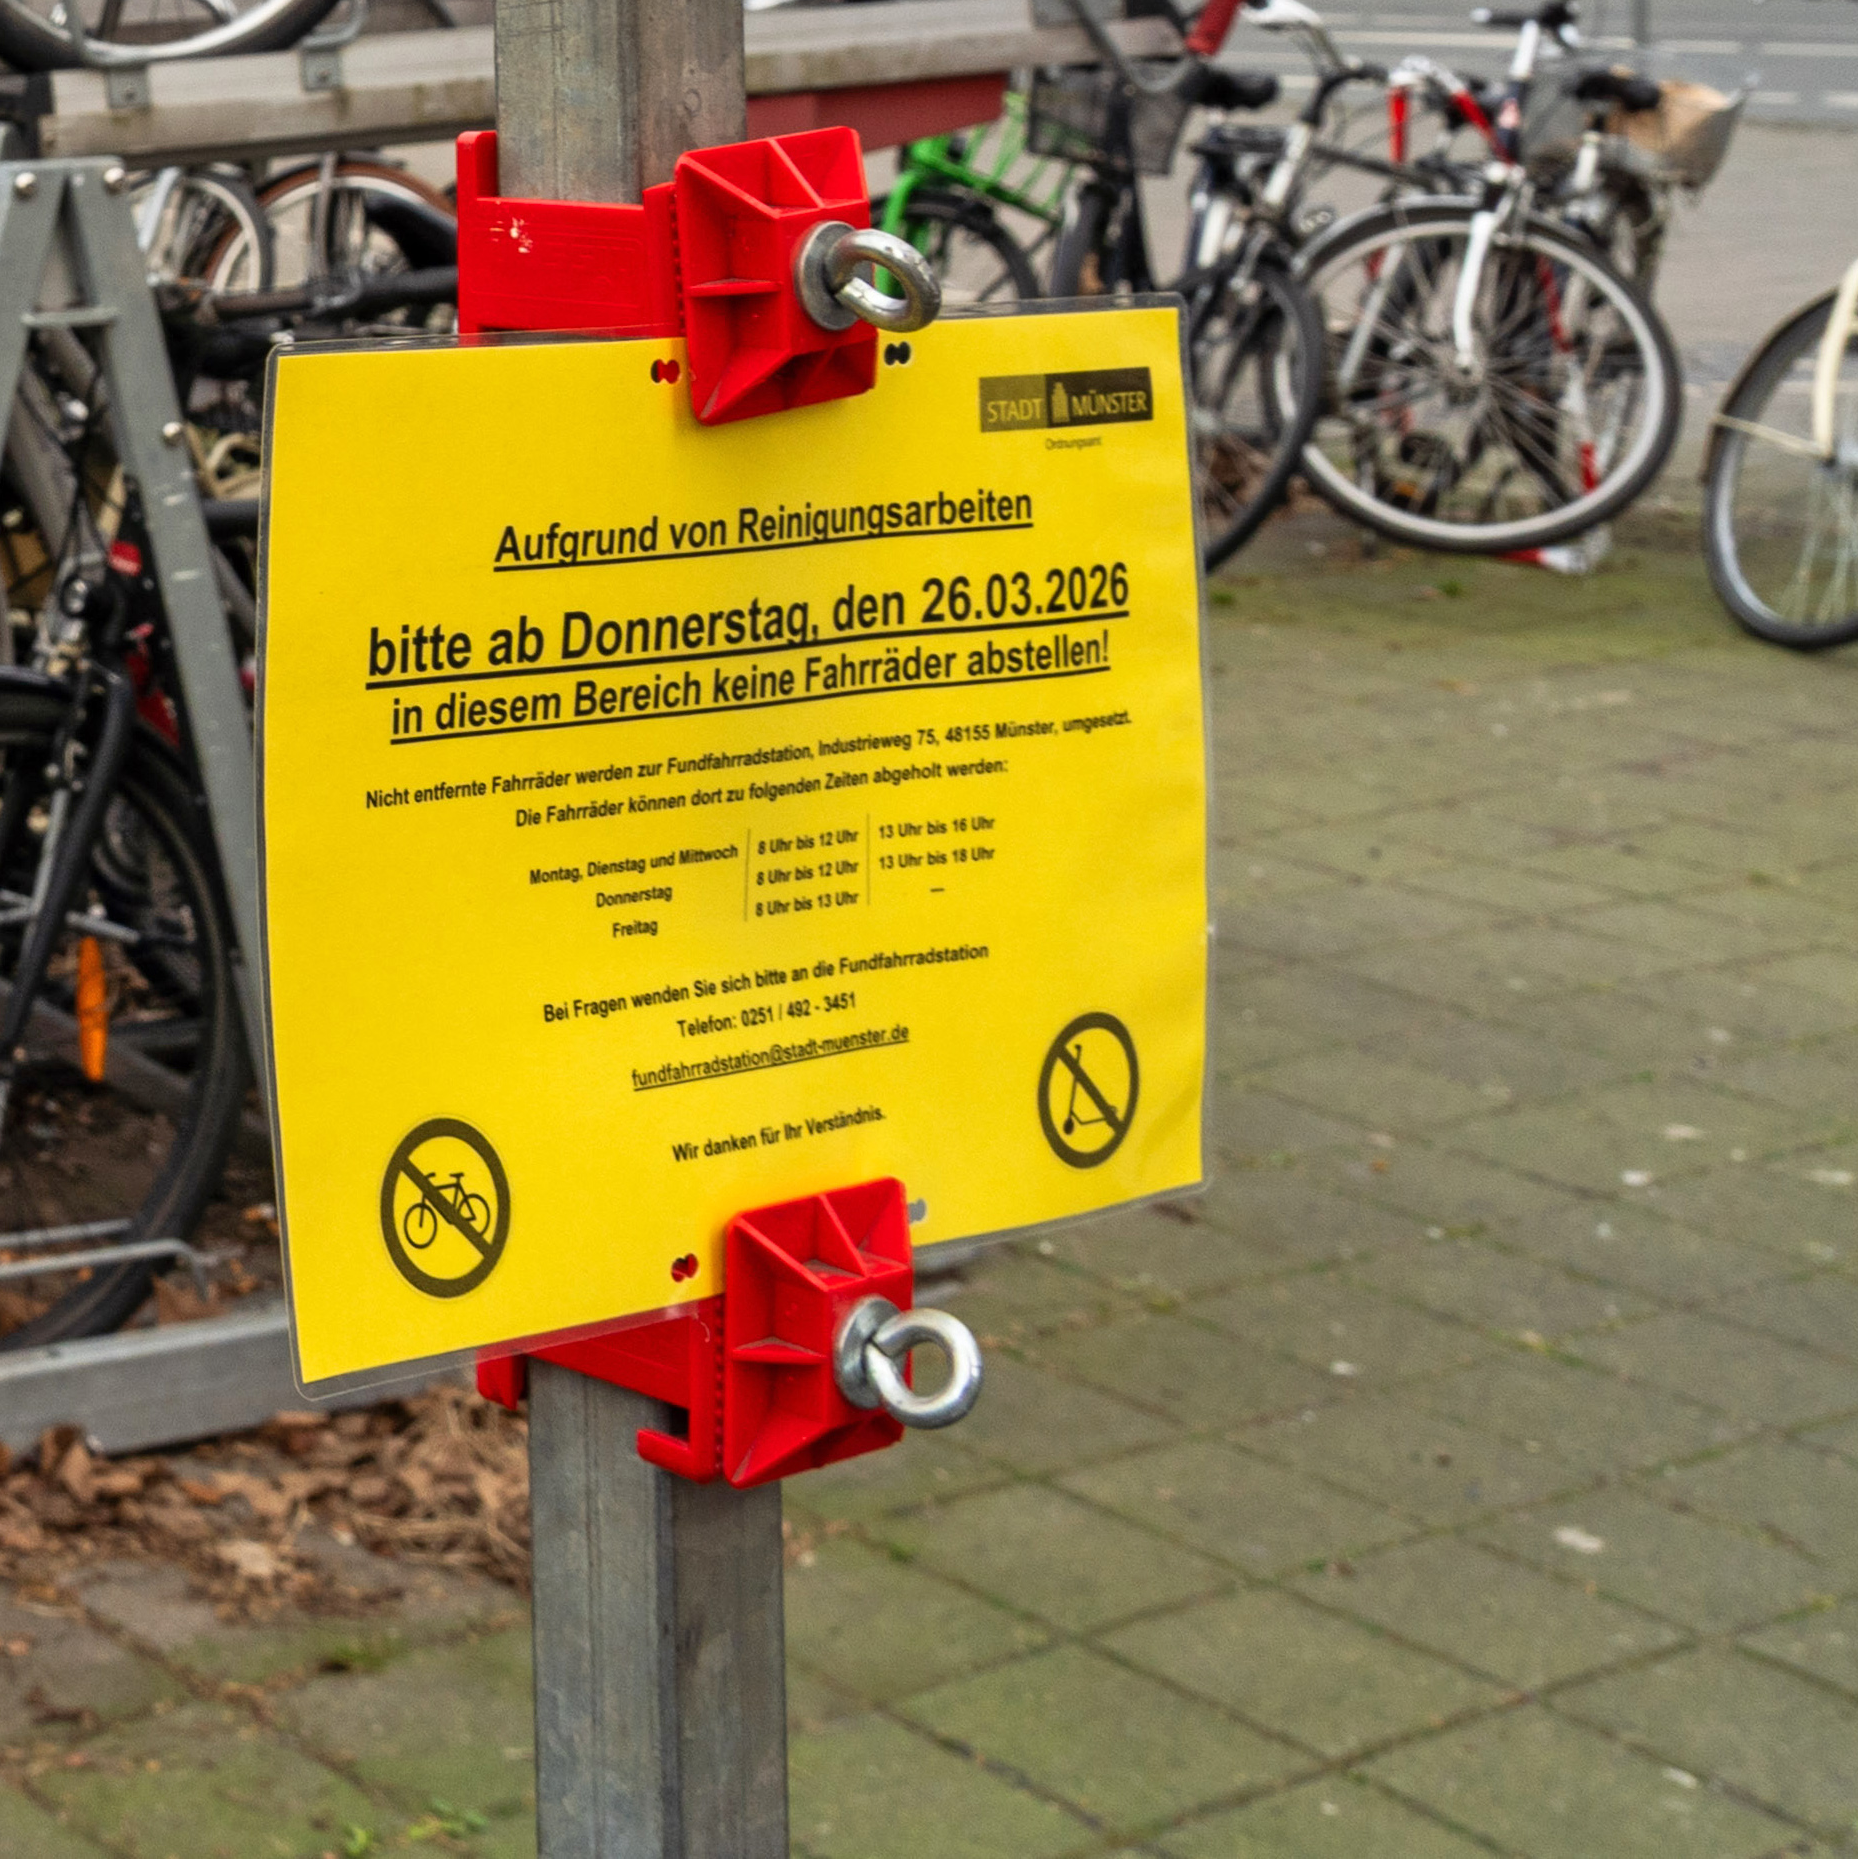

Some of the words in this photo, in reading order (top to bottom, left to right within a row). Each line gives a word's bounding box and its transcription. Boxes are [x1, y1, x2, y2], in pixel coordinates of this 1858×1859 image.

[986, 397, 1045, 424] STADT
[1071, 389, 1148, 417] MÜNSTER
[494, 515, 659, 565] Aufgrund
[669, 518, 726, 549] von
[738, 489, 1033, 544] Reinigungsarbeiten
[368, 623, 472, 676] bitte
[488, 615, 544, 666] ab
[561, 596, 819, 660] Donnerstag,
[833, 584, 905, 631] den
[921, 561, 1130, 623] 26.03.2026
[392, 698, 423, 734] in
[435, 689, 561, 730] diesem
[574, 670, 701, 718] Bereich
[712, 664, 795, 703] keine
[804, 645, 957, 693] Fahrräder
[967, 629, 1110, 676] abstellen!
[366, 787, 409, 809] Nicht
[414, 778, 487, 804] entfernte
[491, 770, 571, 795] Fahrräder
[575, 764, 633, 785] werden
[637, 761, 662, 778] zur
[667, 743, 814, 775] Fundfahrradstation,
[818, 730, 912, 757] Industrieweg
[917, 728, 939, 746] 75,
[945, 723, 990, 742] 48155
[995, 719, 1058, 740] Münster,
[1062, 709, 1132, 734] umgesetzt.
[516, 808, 541, 827] Die
[546, 799, 624, 824] Fahrräder
[628, 793, 686, 814] können
[691, 788, 722, 806] dort
[727, 787, 744, 802] zu
[749, 776, 822, 802] folgenden
[825, 769, 868, 790] Zeiten
[873, 761, 942, 786] abgeholt
[947, 758, 1009, 778] werden:
[758, 839, 766, 855] 8
[769, 836, 792, 855] Uhr
[796, 833, 815, 850] bis
[819, 830, 833, 848] 12
[837, 828, 859, 846] Uhr
[879, 823, 894, 839] 13
[898, 819, 922, 837] Uhr
[927, 818, 947, 835] bis
[952, 816, 967, 833] 16
[971, 814, 995, 831] Uhr
[530, 864, 583, 885] Montag,
[587, 856, 646, 878] Dienstag
[650, 851, 675, 869] und
[679, 844, 738, 865] Mittwoch
[756, 870, 764, 886] 8
[768, 867, 792, 885] Uhr
[795, 864, 814, 881] bis
[818, 861, 832, 879] 12
[836, 858, 859, 877] Uhr
[879, 854, 894, 870] 13
[898, 850, 922, 868] Uhr
[927, 848, 947, 866] bis
[952, 847, 967, 864] 18
[971, 845, 995, 862] Uhr
[596, 884, 673, 908] Donnerstag
[755, 901, 764, 917] 8
[767, 898, 790, 917] Uhr
[793, 895, 813, 912] bis
[817, 892, 831, 909] 13
[836, 889, 859, 907] Uhr
[613, 919, 658, 939] Freitag
[543, 1002, 569, 1022] Bei
[573, 994, 627, 1020] Fragen
[632, 986, 689, 1008] wenden
[693, 979, 716, 998] Sie
[721, 974, 751, 994] sich
[755, 967, 787, 989] bitte
[791, 967, 809, 983] an
[813, 960, 835, 979] die
[839, 943, 989, 974] Fundfahrradstation
[677, 1013, 737, 1038] Telefon:
[741, 1006, 774, 1026] 0251
[786, 999, 811, 1018] 492
[824, 992, 856, 1012] 3451
[631, 1023, 910, 1089] fundfahrradstation@stadt-muenster.de
[672, 1143, 699, 1163] Wir
[704, 1133, 757, 1158] danken
[760, 1127, 780, 1145] für
[784, 1122, 803, 1141] Ihr
[805, 1103, 887, 1135] Verständnis.
